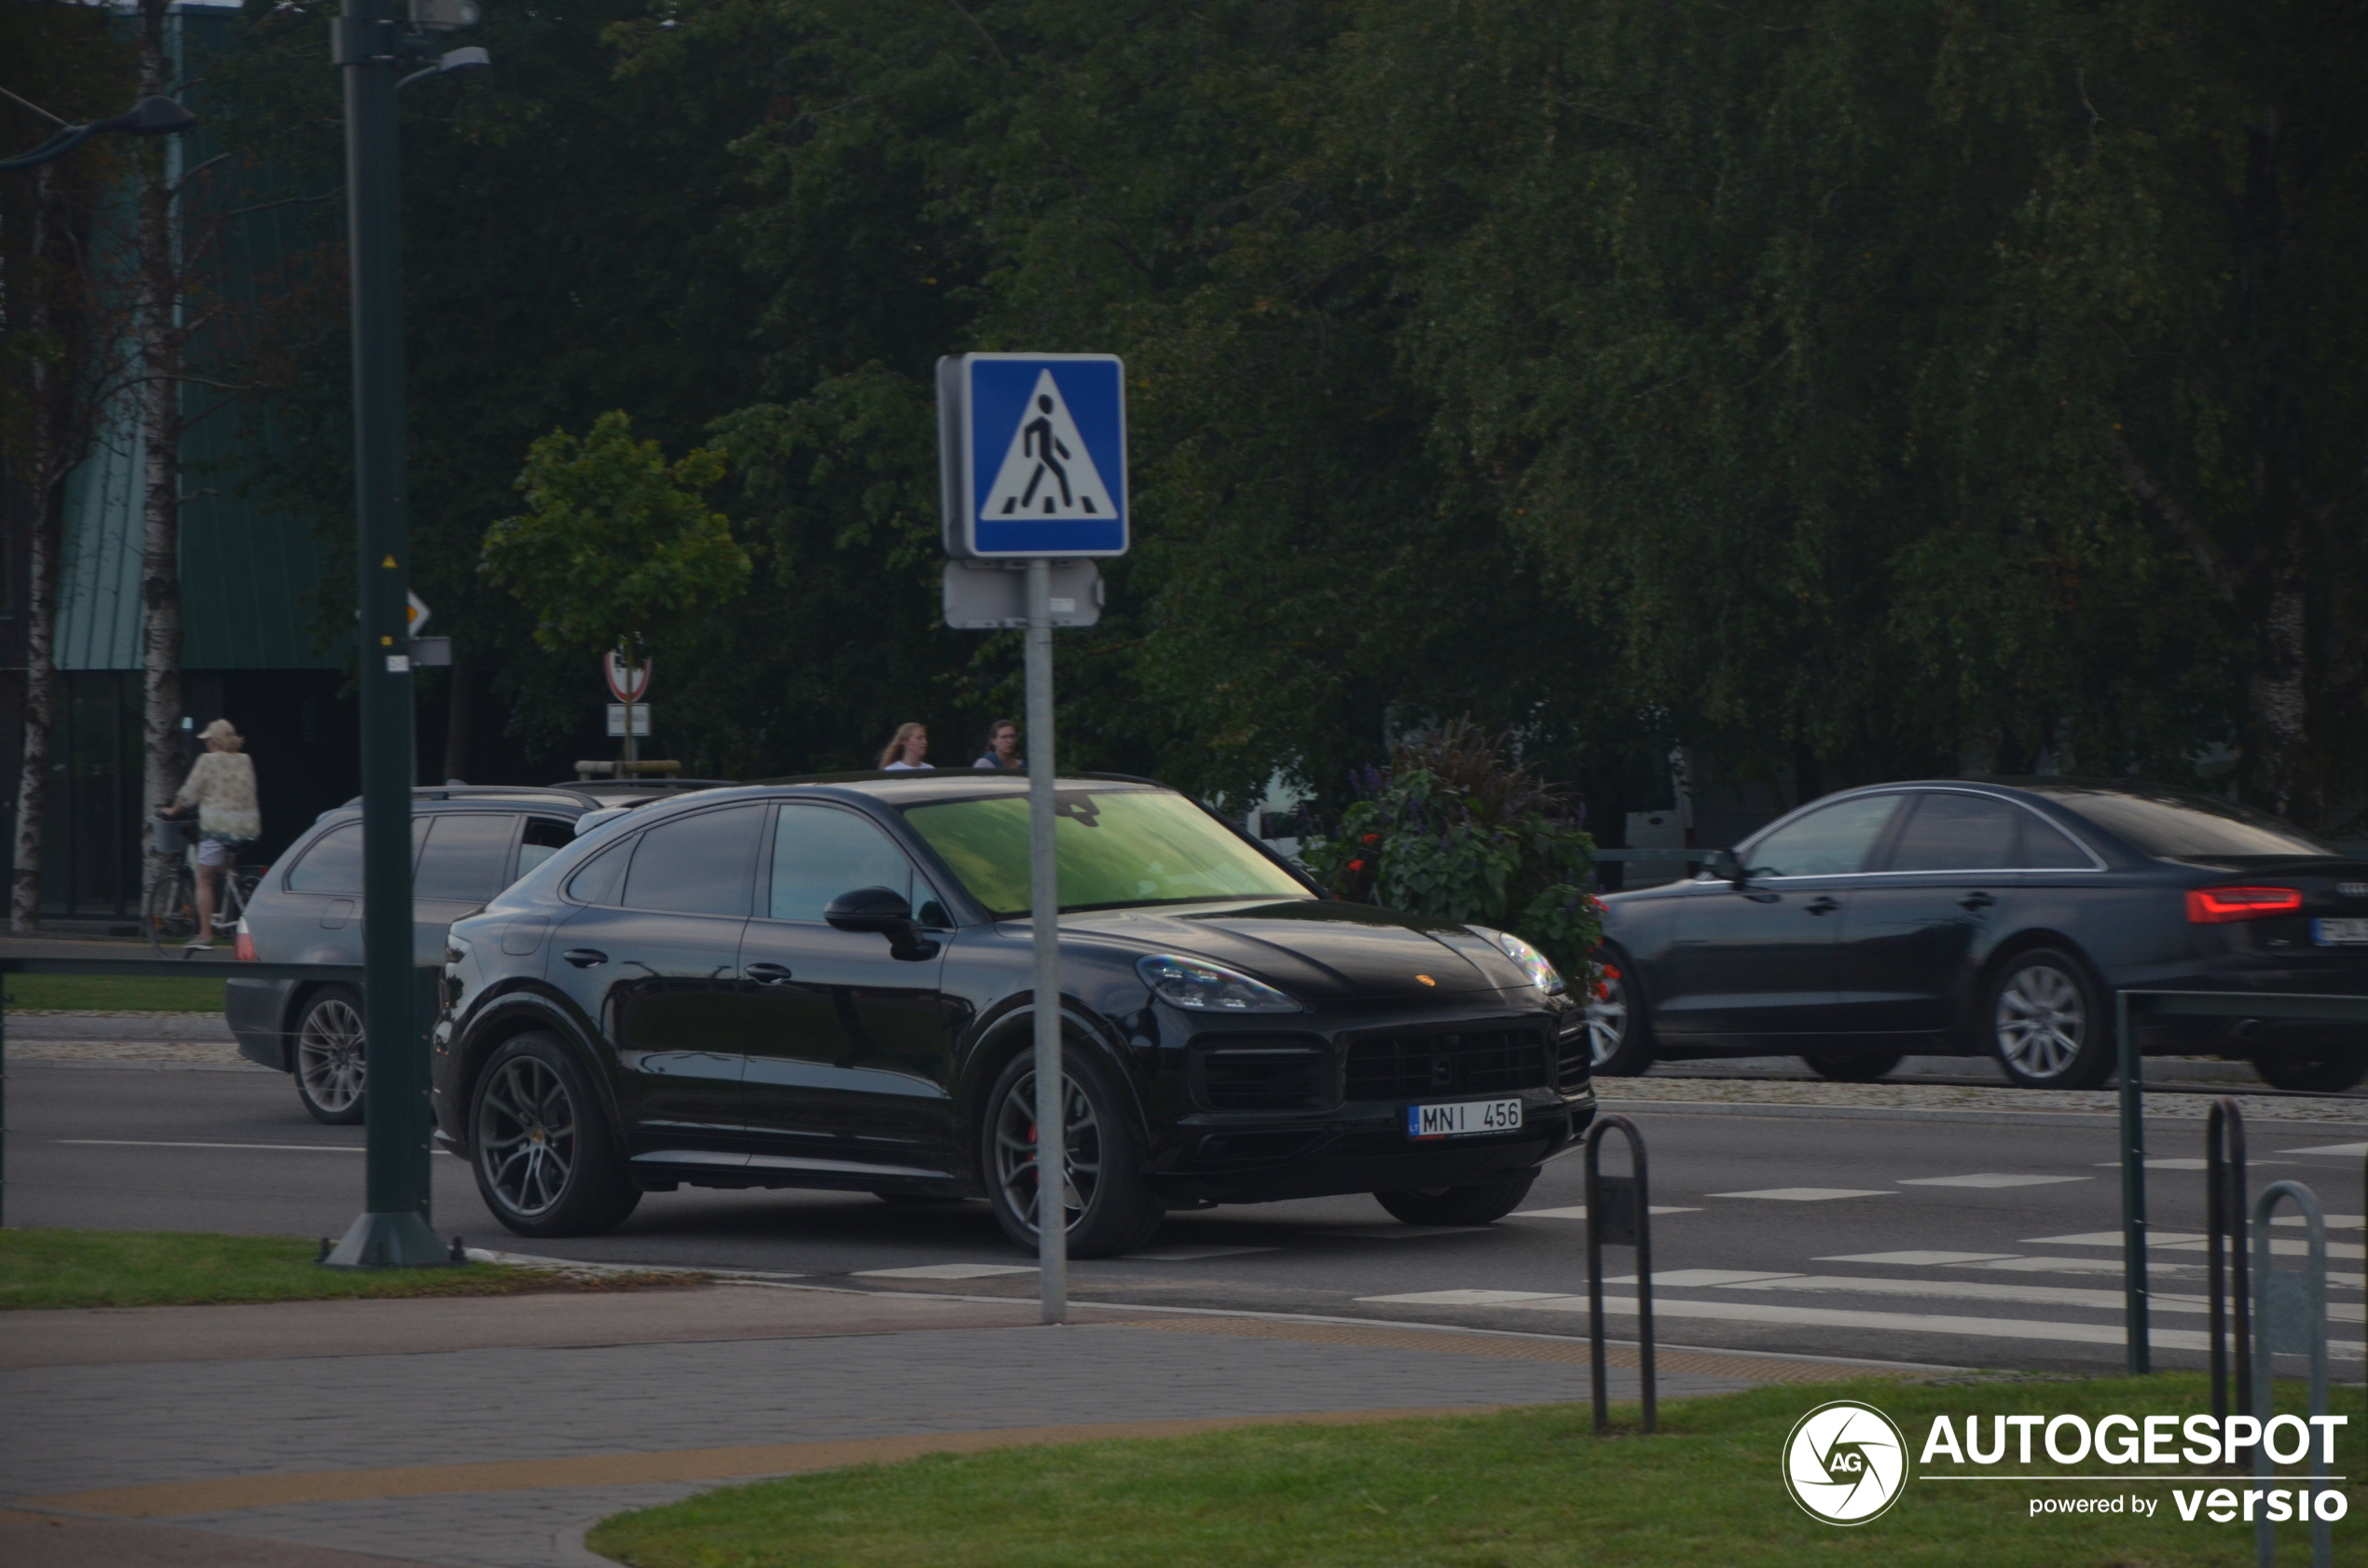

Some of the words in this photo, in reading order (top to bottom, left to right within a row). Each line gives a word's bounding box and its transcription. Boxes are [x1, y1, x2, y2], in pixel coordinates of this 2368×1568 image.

[1423, 1106, 1465, 1133] MNI
[1483, 1102, 1519, 1128] 456
[1409, 1123, 1419, 1133] LT
